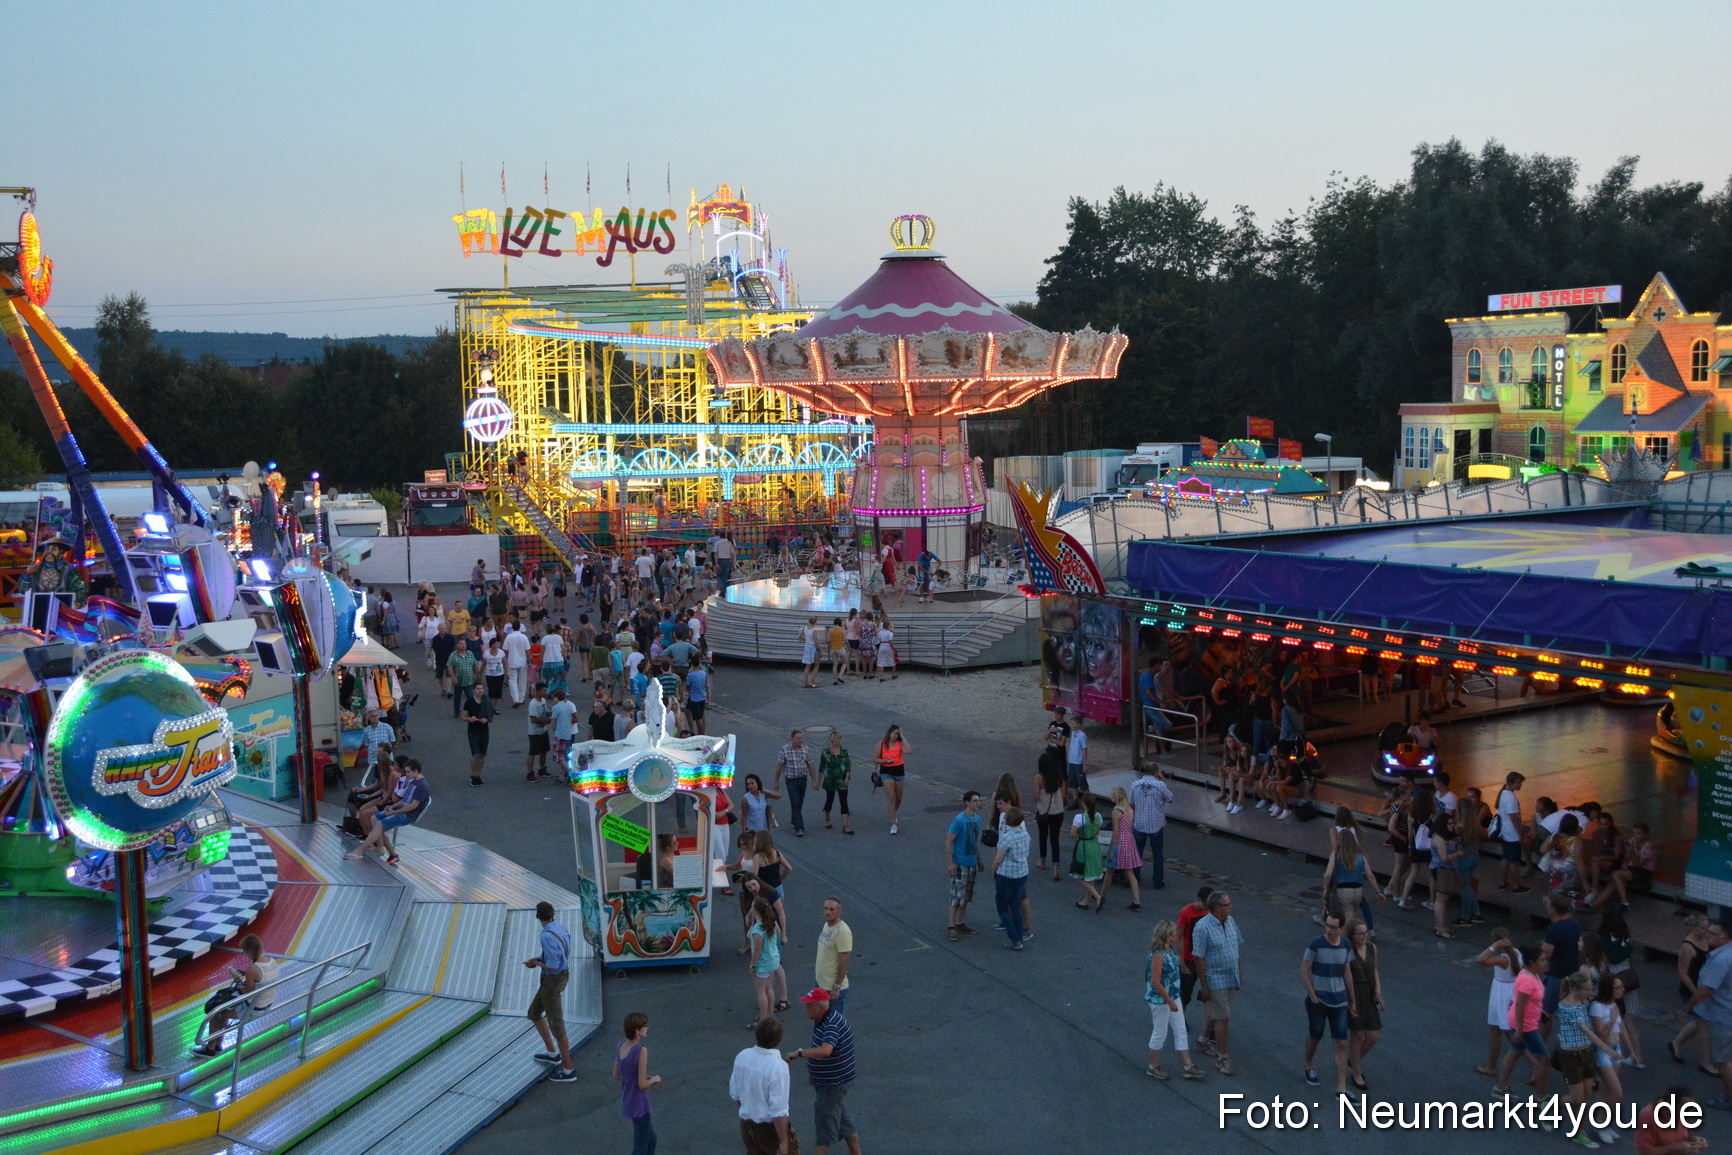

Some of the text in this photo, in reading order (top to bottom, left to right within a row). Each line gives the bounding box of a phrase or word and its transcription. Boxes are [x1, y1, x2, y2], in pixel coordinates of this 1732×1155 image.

[452, 206, 677, 268] WILDE MAUS
[1501, 288, 1607, 309] FUN STREET
[1555, 348, 1564, 407] HOTEL
[104, 747, 184, 785] HAPPY
